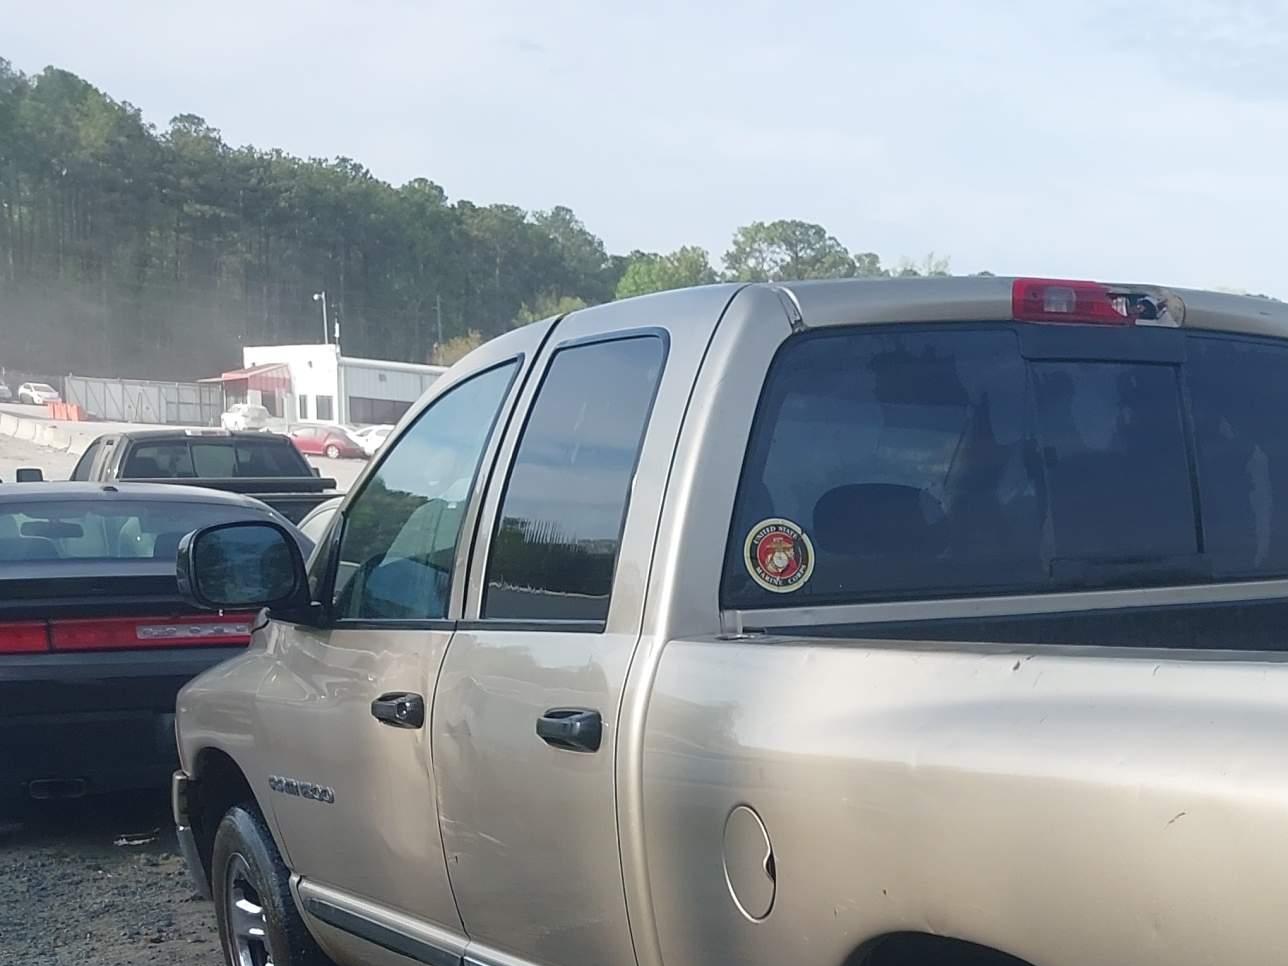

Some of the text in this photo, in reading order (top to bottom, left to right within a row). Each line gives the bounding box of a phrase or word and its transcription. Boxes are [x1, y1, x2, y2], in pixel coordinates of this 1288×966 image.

[753, 526, 776, 544] UNITED
[756, 564, 807, 586] MARINE CORPS
